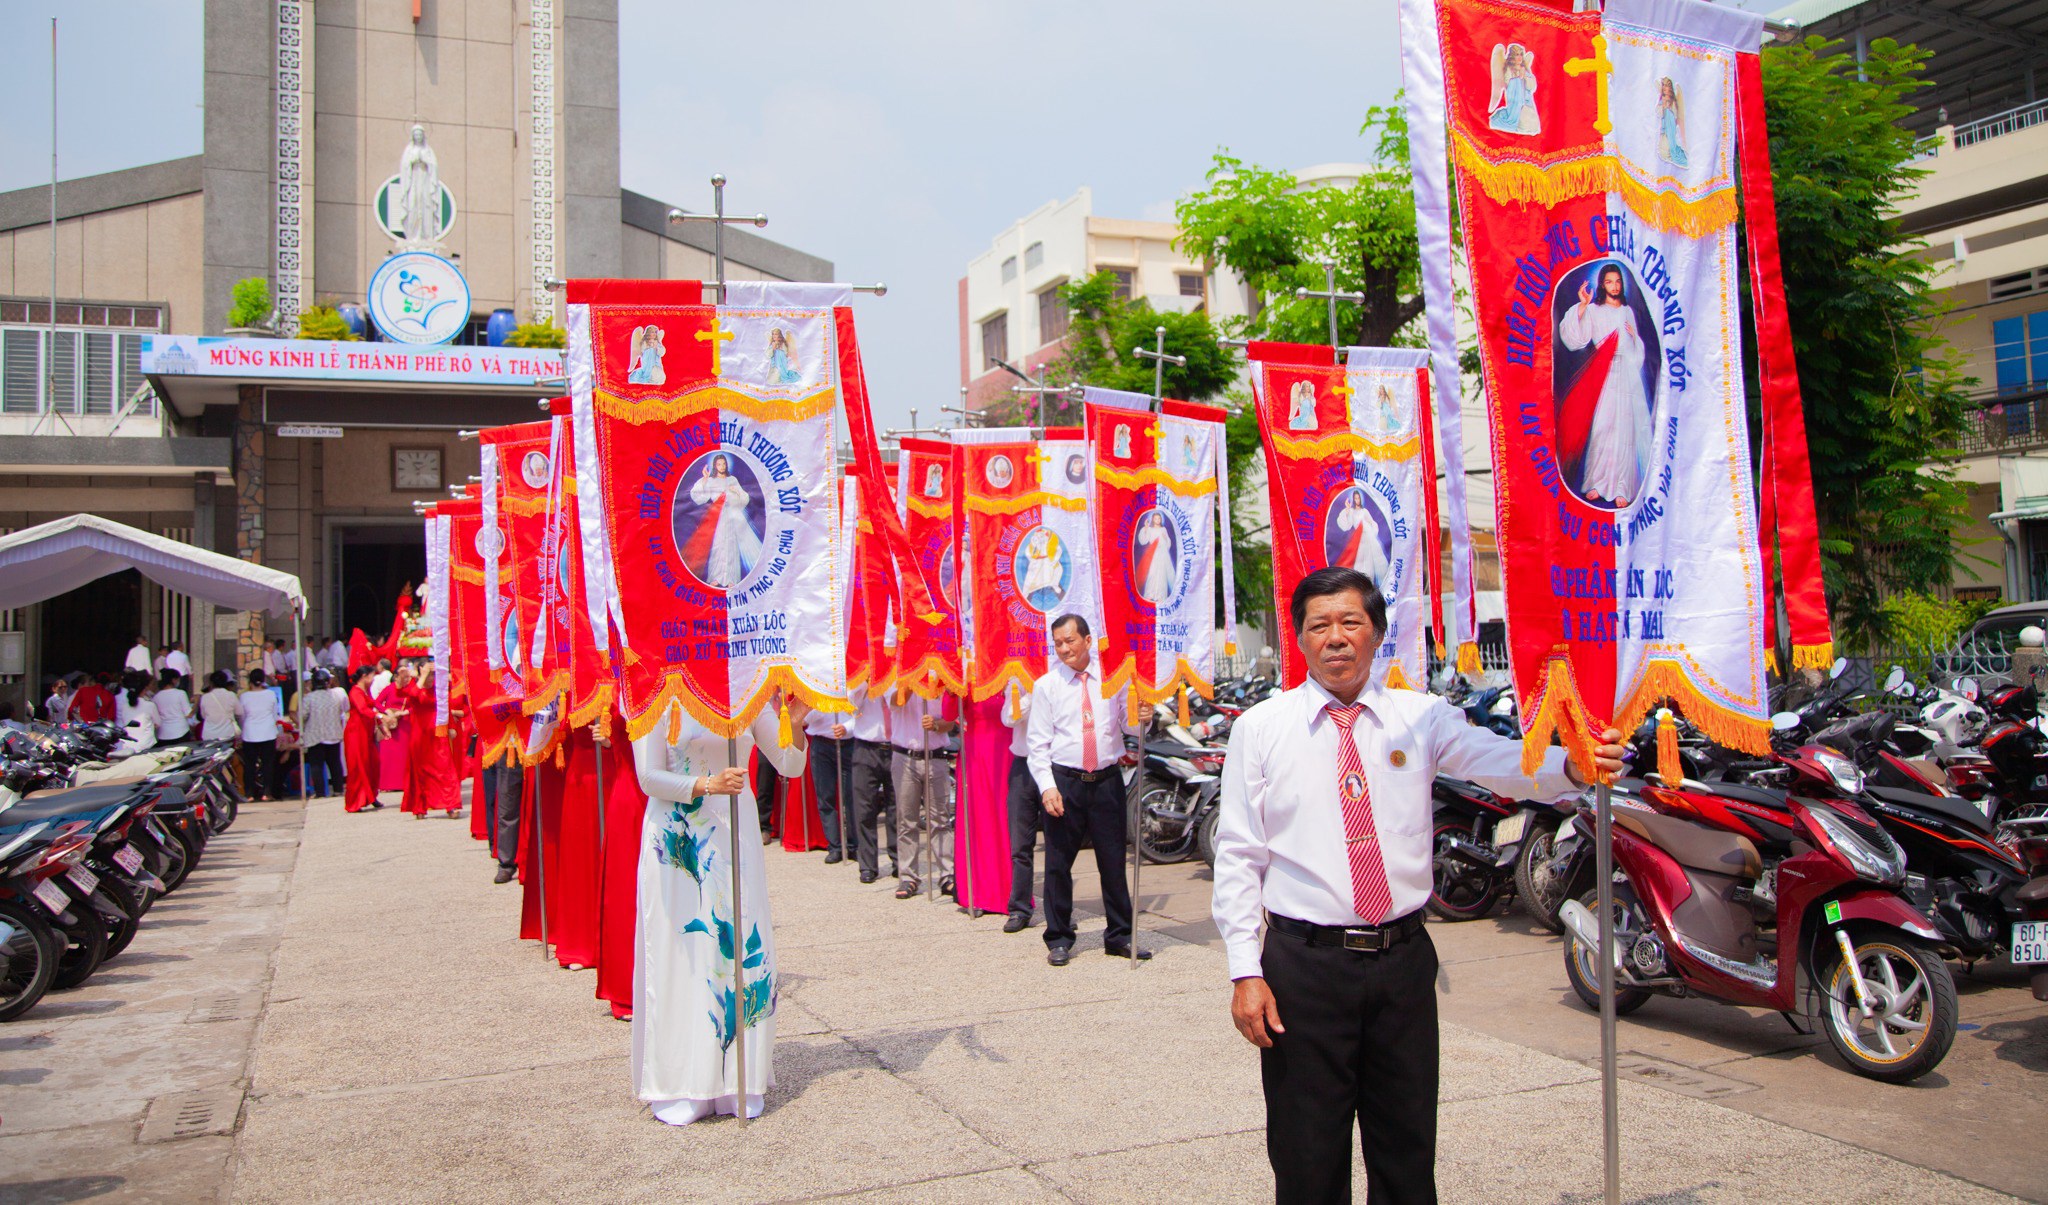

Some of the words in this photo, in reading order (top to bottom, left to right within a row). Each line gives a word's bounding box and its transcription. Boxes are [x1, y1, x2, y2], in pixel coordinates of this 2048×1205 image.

[1506, 301, 1541, 369] HIỆP
[1589, 211, 1636, 265] CHÚA
[1666, 346, 1692, 392] XÓT
[210, 345, 264, 366] MỪNG
[269, 346, 315, 368] KÍNH
[320, 343, 341, 369] LỄ
[347, 349, 408, 371] THÁNH
[509, 355, 565, 377] THÁNH
[665, 425, 705, 458] LÒNG
[709, 418, 744, 447] CHÚA
[647, 453, 675, 483] HỘI
[747, 431, 794, 483] THƯƠNG
[1519, 402, 1542, 437] LẠY
[1588, 520, 1622, 547] CON
[637, 482, 665, 519] HIỆP
[777, 486, 808, 514] XÓT
[1372, 471, 1401, 514] THƯƠNG
[1393, 517, 1411, 539] XÓT
[1017, 508, 1041, 528] CHA
[776, 529, 795, 555] CHÚA
[767, 557, 787, 576] VÀO
[748, 575, 774, 599] THÁC
[1566, 561, 1618, 605] PHẬN
[711, 595, 732, 610] CON
[734, 590, 748, 608] TÍN
[661, 616, 688, 638] GIÁO
[732, 612, 759, 635] XUÂN
[763, 609, 787, 634] LỘC
[1578, 611, 1619, 649] HẠT
[1641, 611, 1664, 640] MAI
[665, 640, 689, 662] GIÁO
[694, 638, 712, 660] XỨ
[715, 640, 747, 659] TRINH
[750, 635, 787, 655] VƯƠNG
[1782, 867, 1806, 879] HONDA
